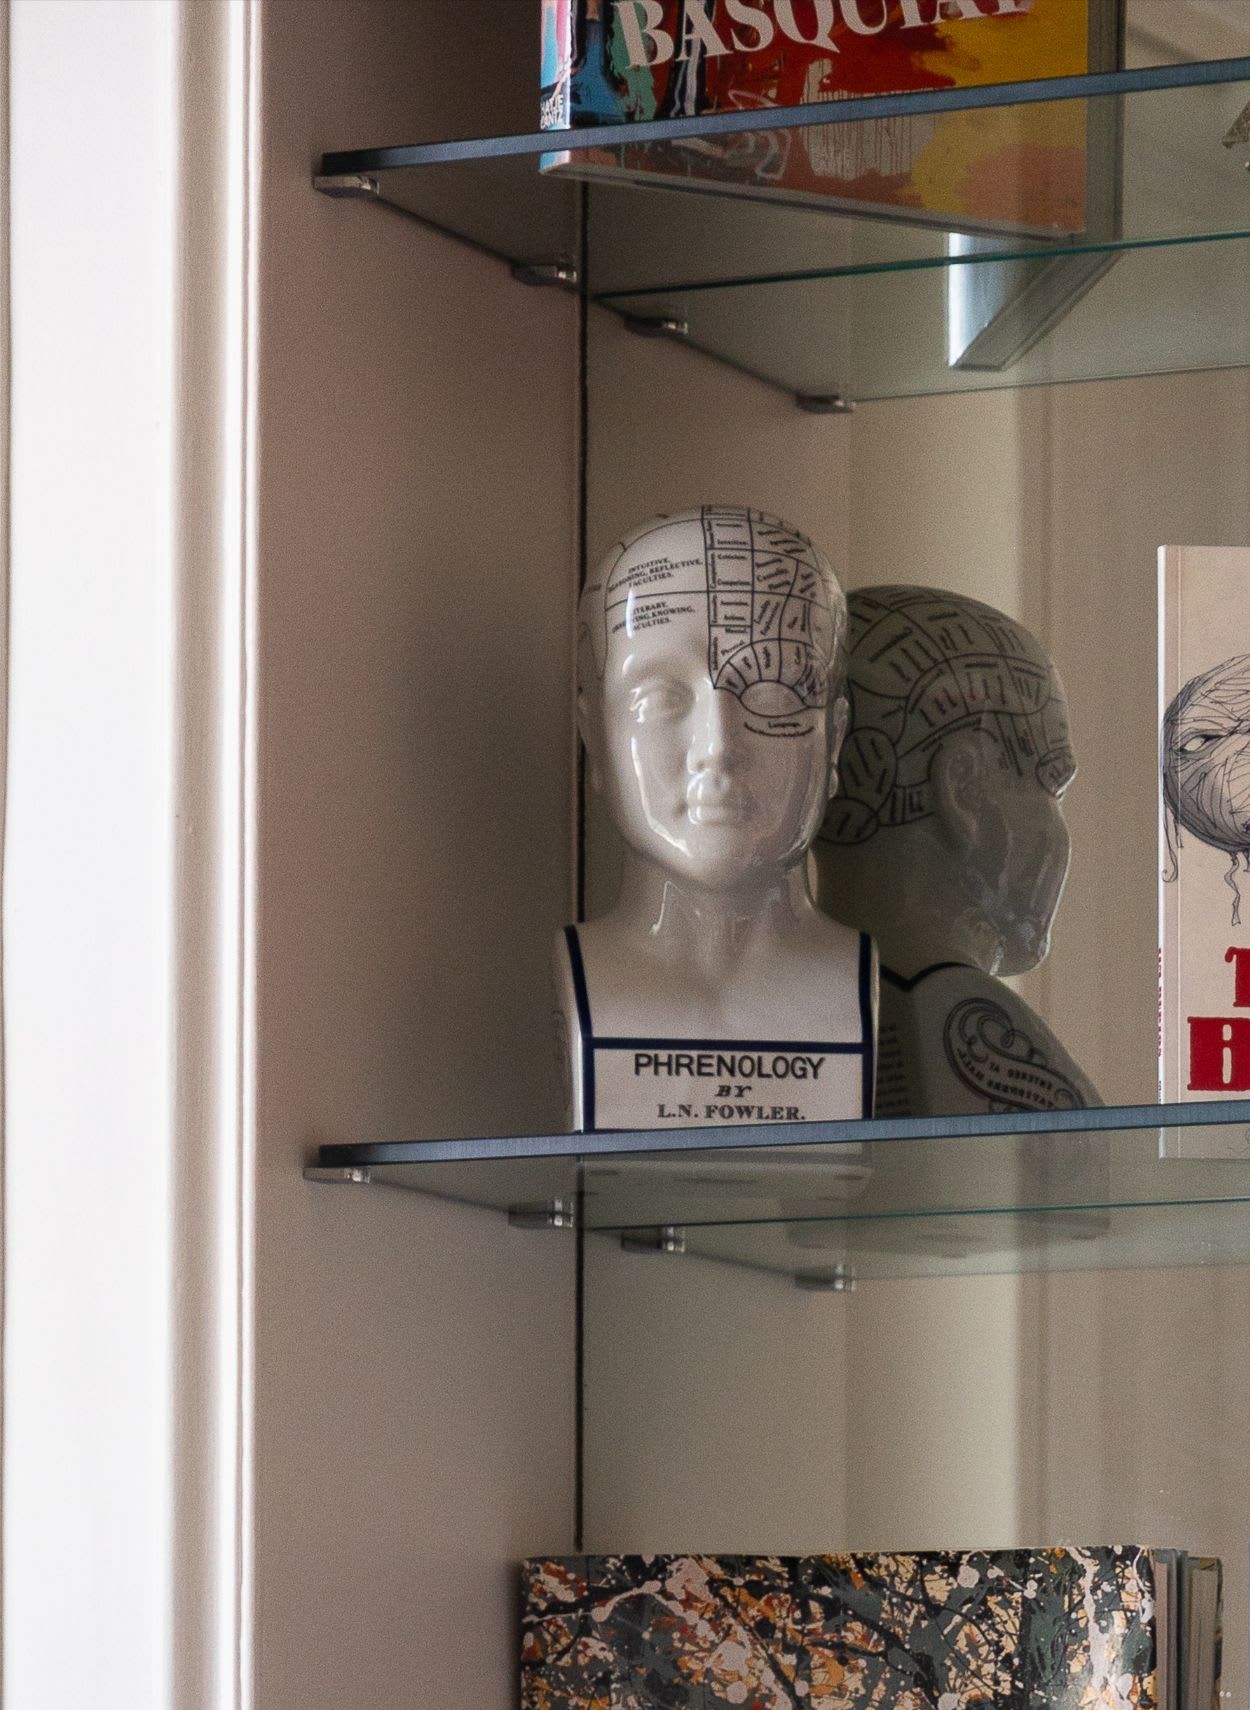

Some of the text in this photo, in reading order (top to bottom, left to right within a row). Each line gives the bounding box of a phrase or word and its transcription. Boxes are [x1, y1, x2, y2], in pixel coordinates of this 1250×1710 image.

[611, 0, 1031, 69] BASQU
[633, 1053, 826, 1081] PHRENOLOGY
[715, 1084, 751, 1097] BY
[657, 1104, 806, 1121] L.N. FOWLER.
